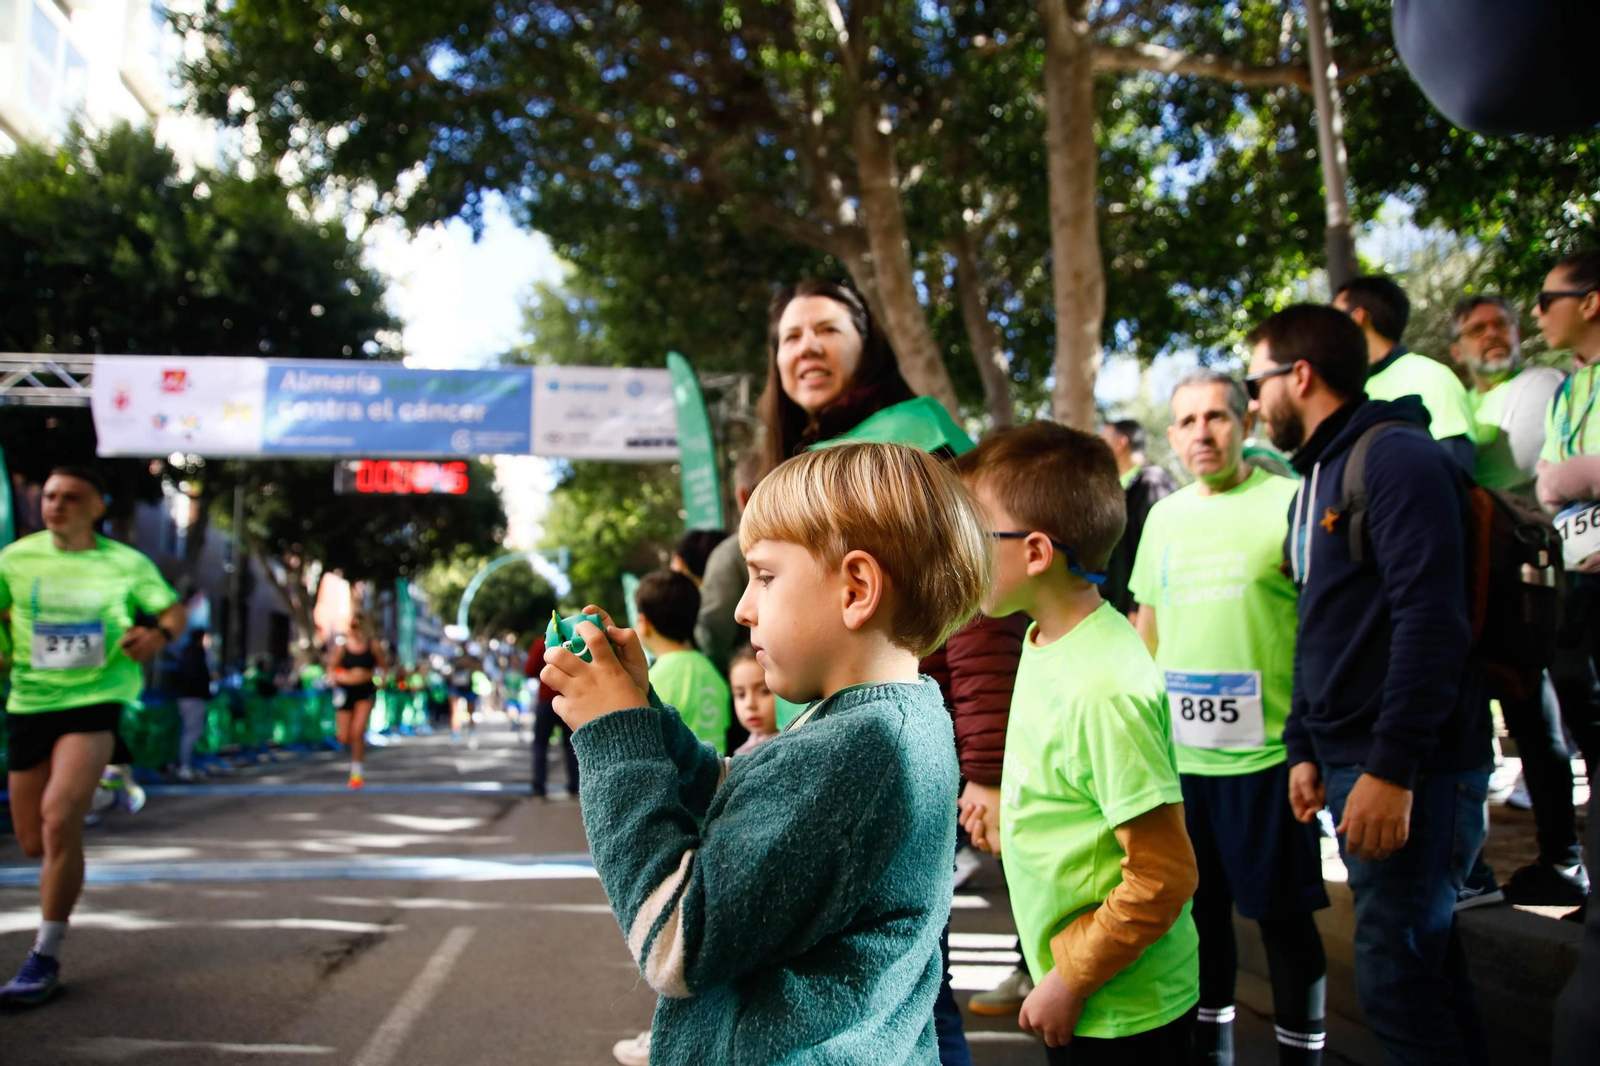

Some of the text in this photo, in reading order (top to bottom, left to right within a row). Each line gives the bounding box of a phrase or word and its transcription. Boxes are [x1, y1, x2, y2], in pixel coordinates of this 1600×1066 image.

[279, 369, 382, 395] Almería
[278, 398, 487, 423] contra el cáncer
[45, 635, 91, 653] 273
[1181, 697, 1239, 723] 885
